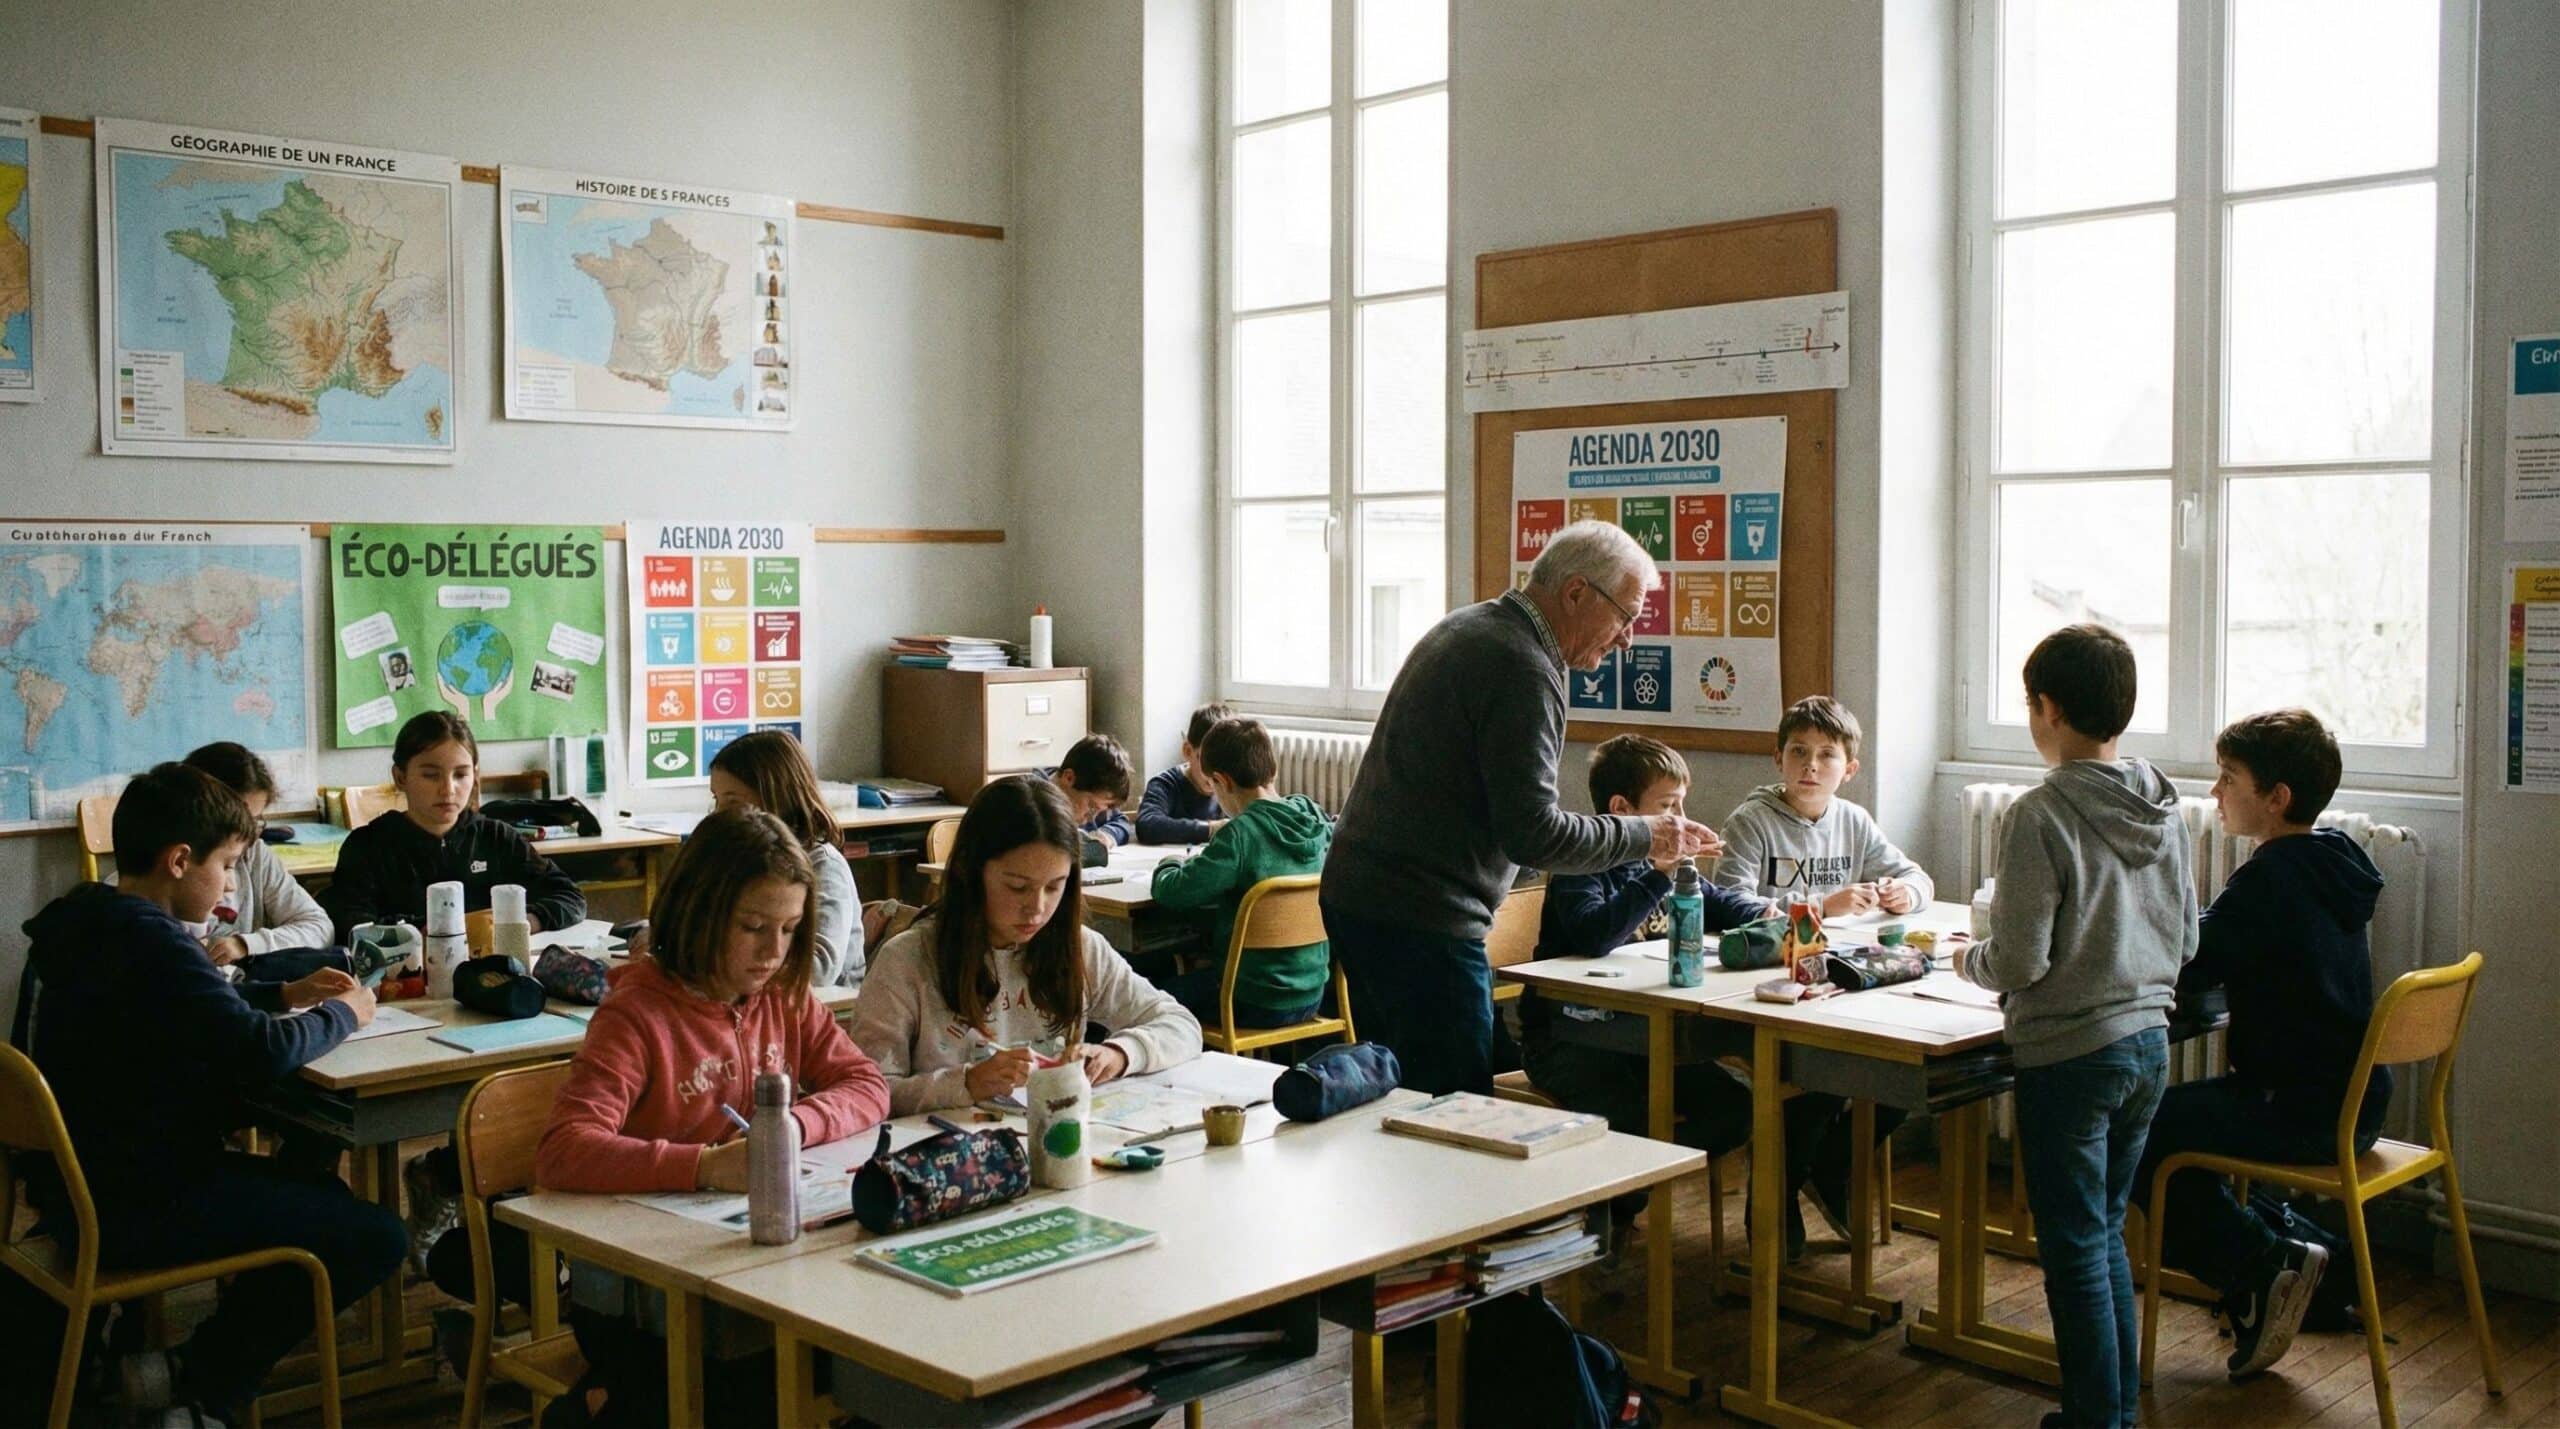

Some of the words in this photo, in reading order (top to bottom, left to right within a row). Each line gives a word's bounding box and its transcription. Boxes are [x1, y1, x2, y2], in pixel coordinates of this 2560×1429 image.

[282, 147, 303, 162] DE
[308, 150, 331, 165] UN
[575, 179, 637, 197] HISTOIRE
[1568, 432, 1655, 467] AGENDA
[1660, 428, 1720, 463] 2030
[1679, 500, 1686, 515] 5
[1734, 499, 1742, 514] 6
[659, 526, 733, 550] AGENDA
[738, 527, 784, 550] 2030
[341, 531, 597, 579] ÉCO-DÉLÉGUÉS
